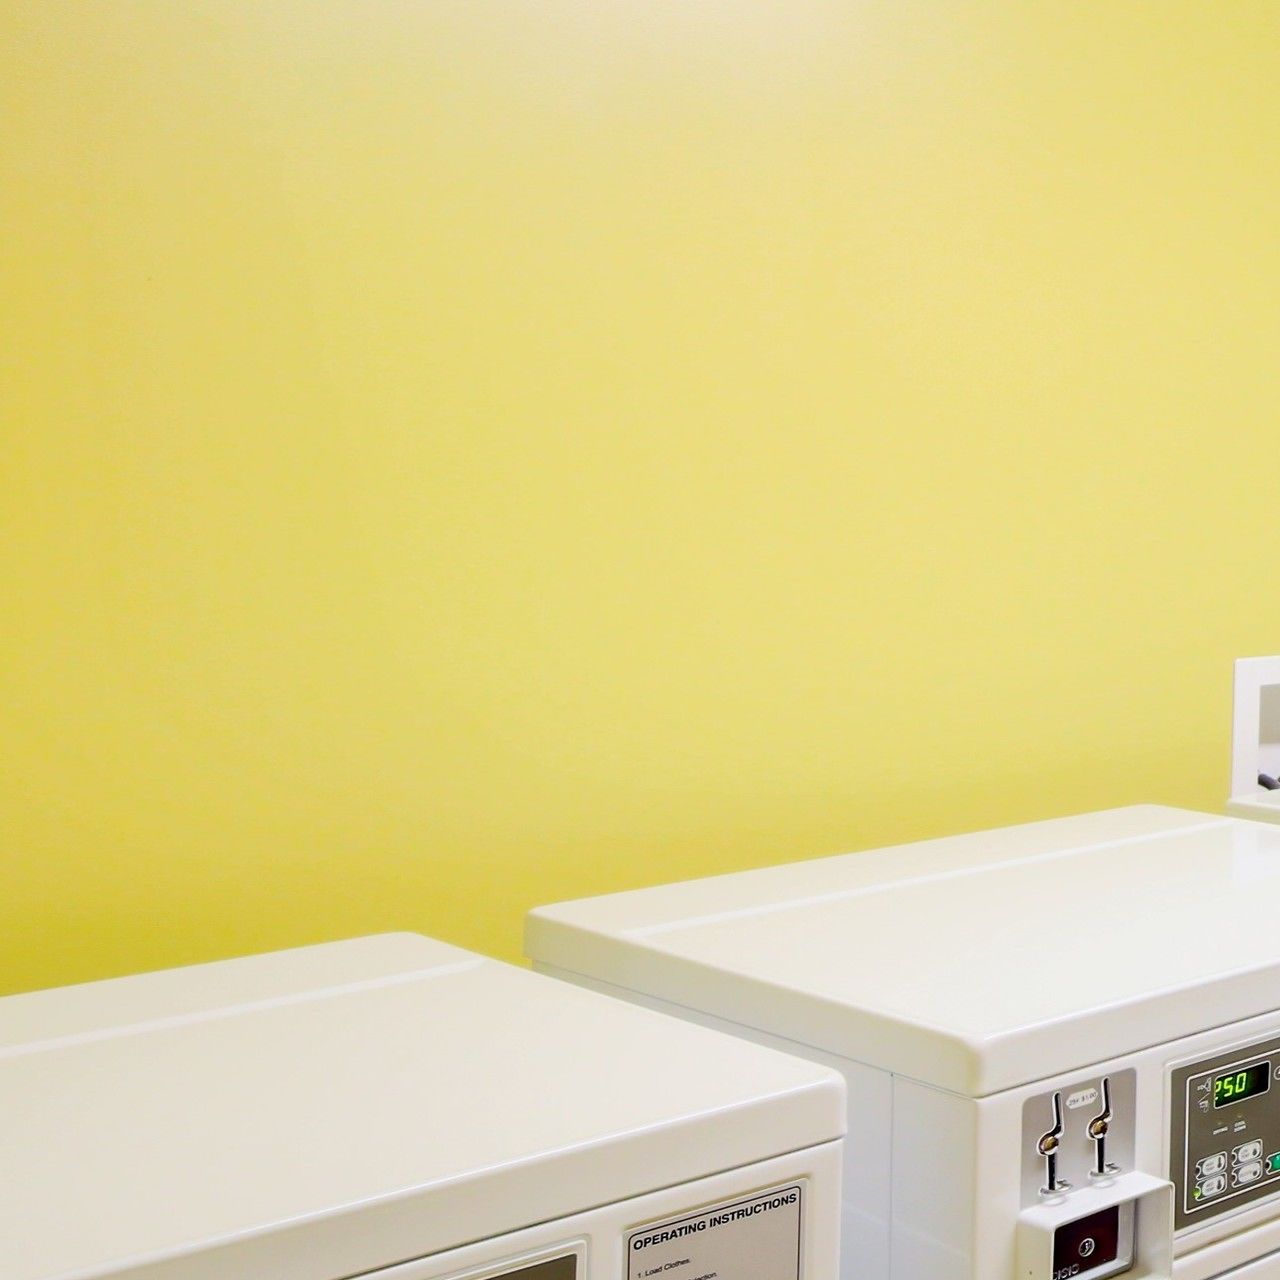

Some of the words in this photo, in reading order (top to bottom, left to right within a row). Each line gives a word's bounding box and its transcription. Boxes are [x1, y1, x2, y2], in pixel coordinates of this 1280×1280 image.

[633, 1221, 707, 1251] OPERATING
[709, 1193, 797, 1228] INSTRUCTIONS
[644, 1266, 662, 1277] Load
